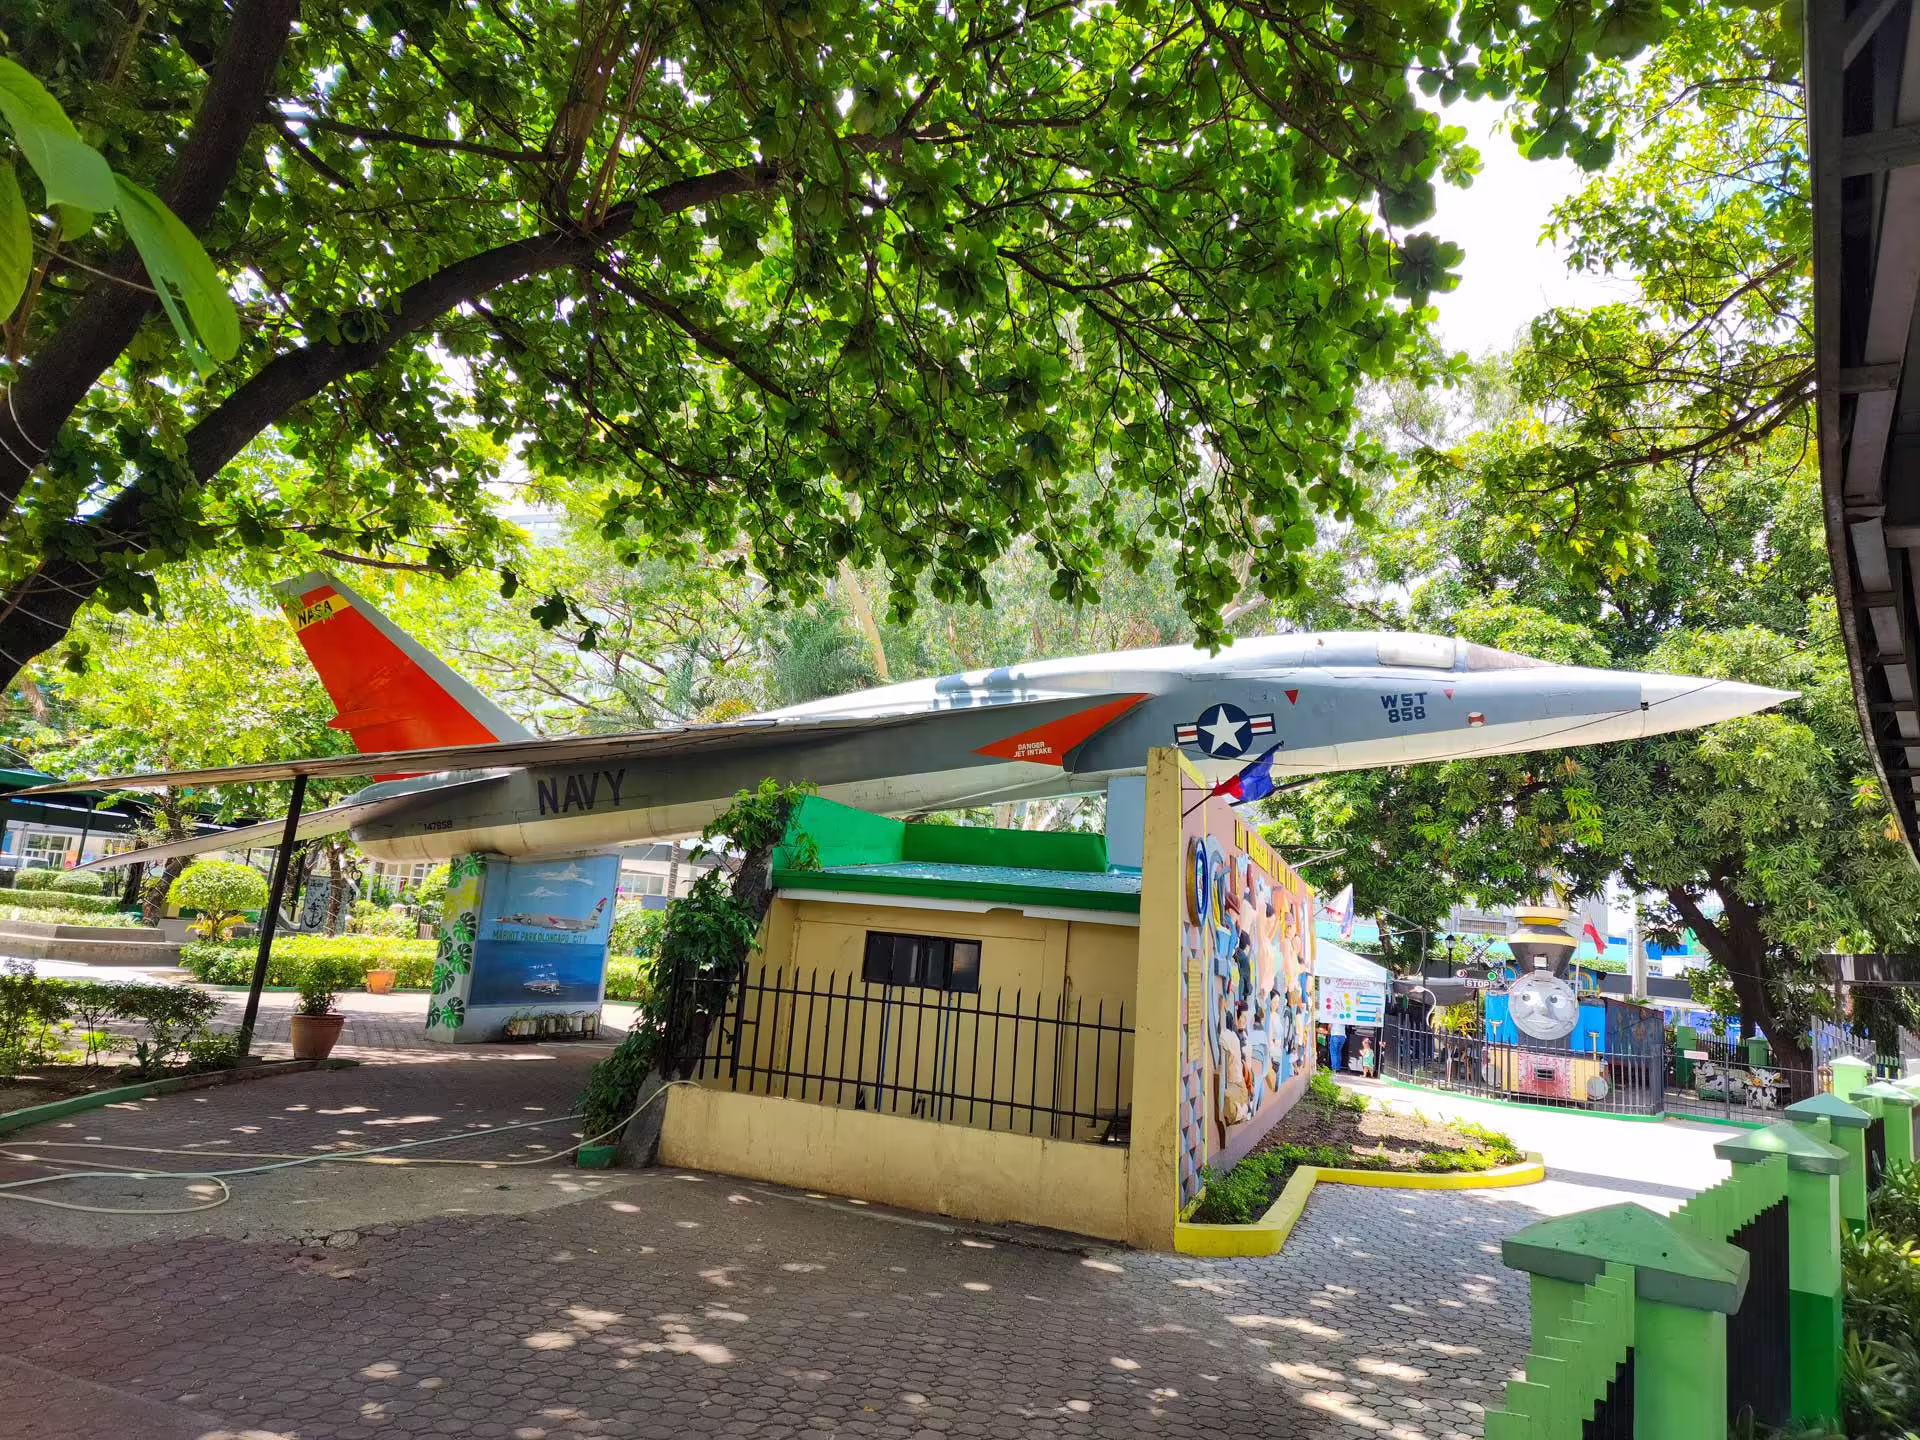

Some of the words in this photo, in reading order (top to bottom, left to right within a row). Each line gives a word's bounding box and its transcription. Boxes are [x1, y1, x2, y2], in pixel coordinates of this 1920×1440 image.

[298, 600, 333, 628] NASA
[1388, 706, 1426, 723] 858
[1013, 750, 1026, 758] JET
[1027, 747, 1053, 756] INTAKE
[1017, 741, 1045, 750] DANGER
[537, 768, 626, 815] NAVY
[573, 935, 588, 944] CITY
